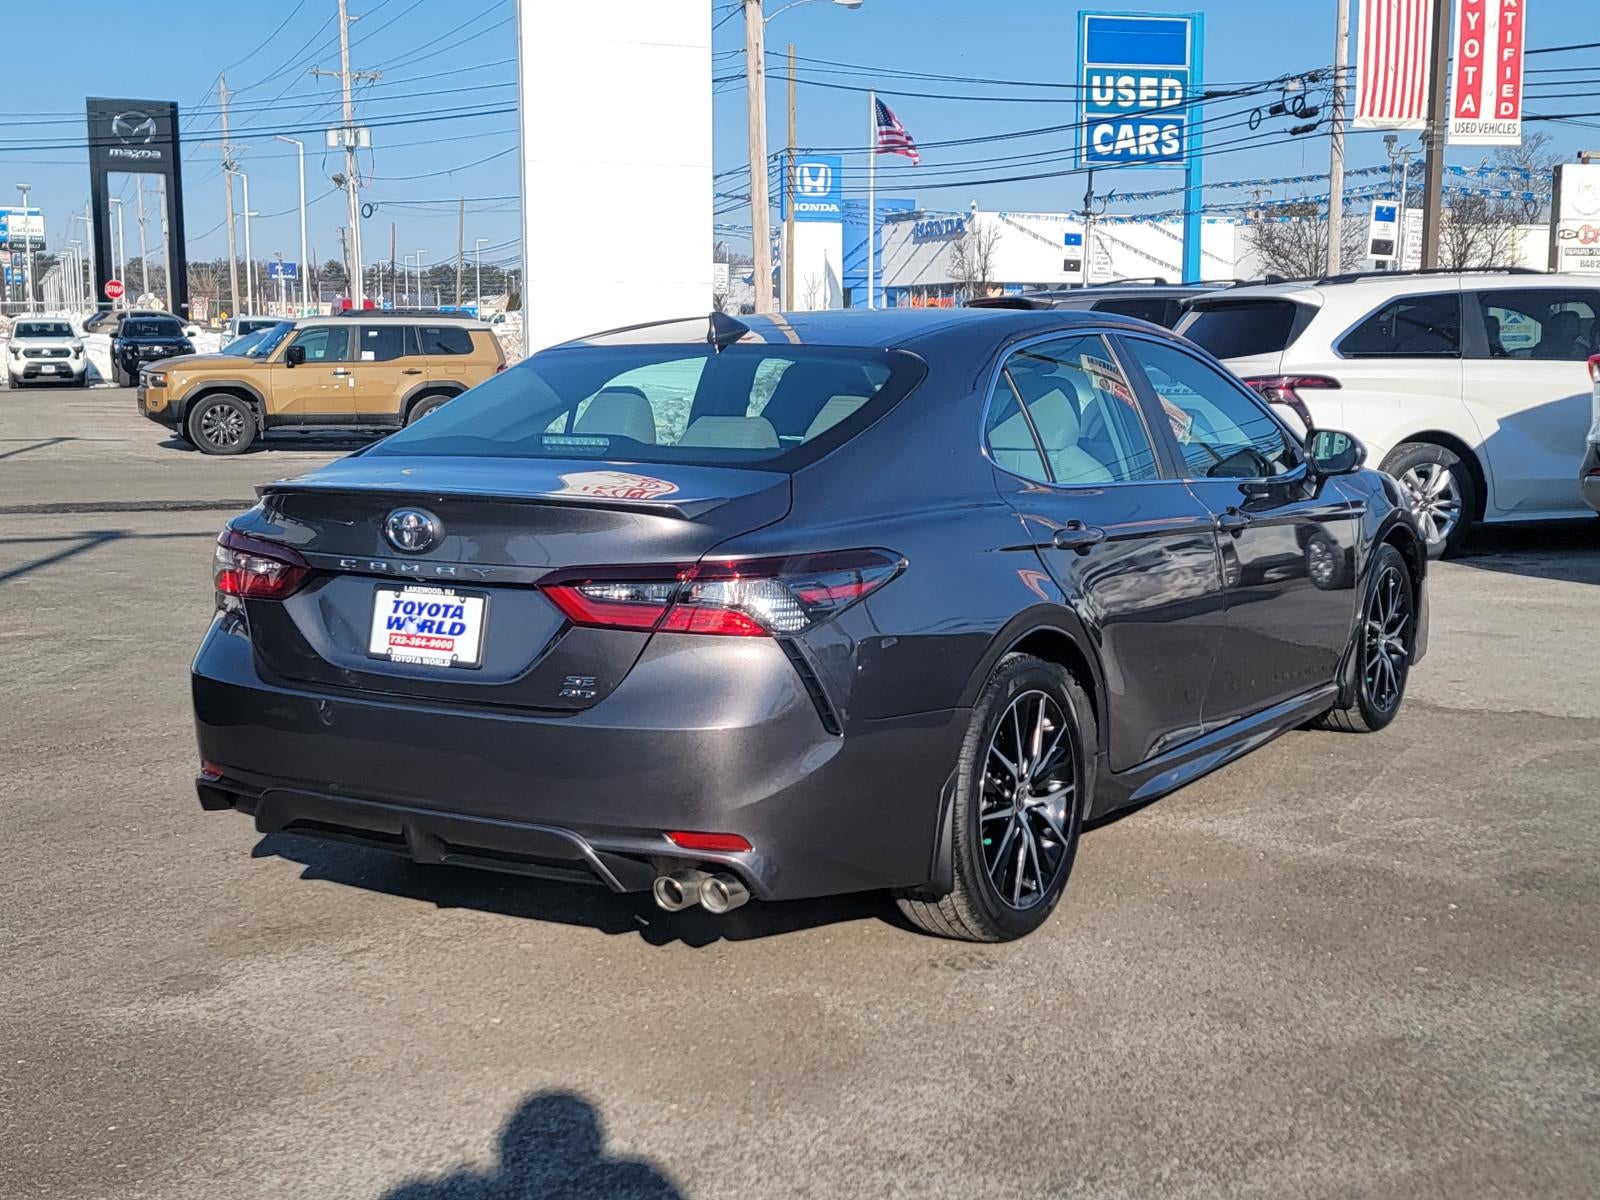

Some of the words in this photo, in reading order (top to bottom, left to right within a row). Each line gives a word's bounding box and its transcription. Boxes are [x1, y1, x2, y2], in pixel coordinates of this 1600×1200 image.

[1460, 0, 1481, 113] YOTA
[1092, 75, 1183, 108] USED
[1454, 122, 1476, 134] USED
[1478, 122, 1517, 134] VEHICLES
[1093, 123, 1180, 155] CARS
[913, 218, 967, 242] HONDA
[107, 285, 123, 294] STOP
[340, 559, 495, 578] CAMRY
[392, 600, 464, 619] TOYOTA
[386, 616, 466, 636] WORLD
[391, 654, 422, 664] TOYOTA
[422, 656, 451, 666] WORLD
[563, 675, 597, 687] SE
